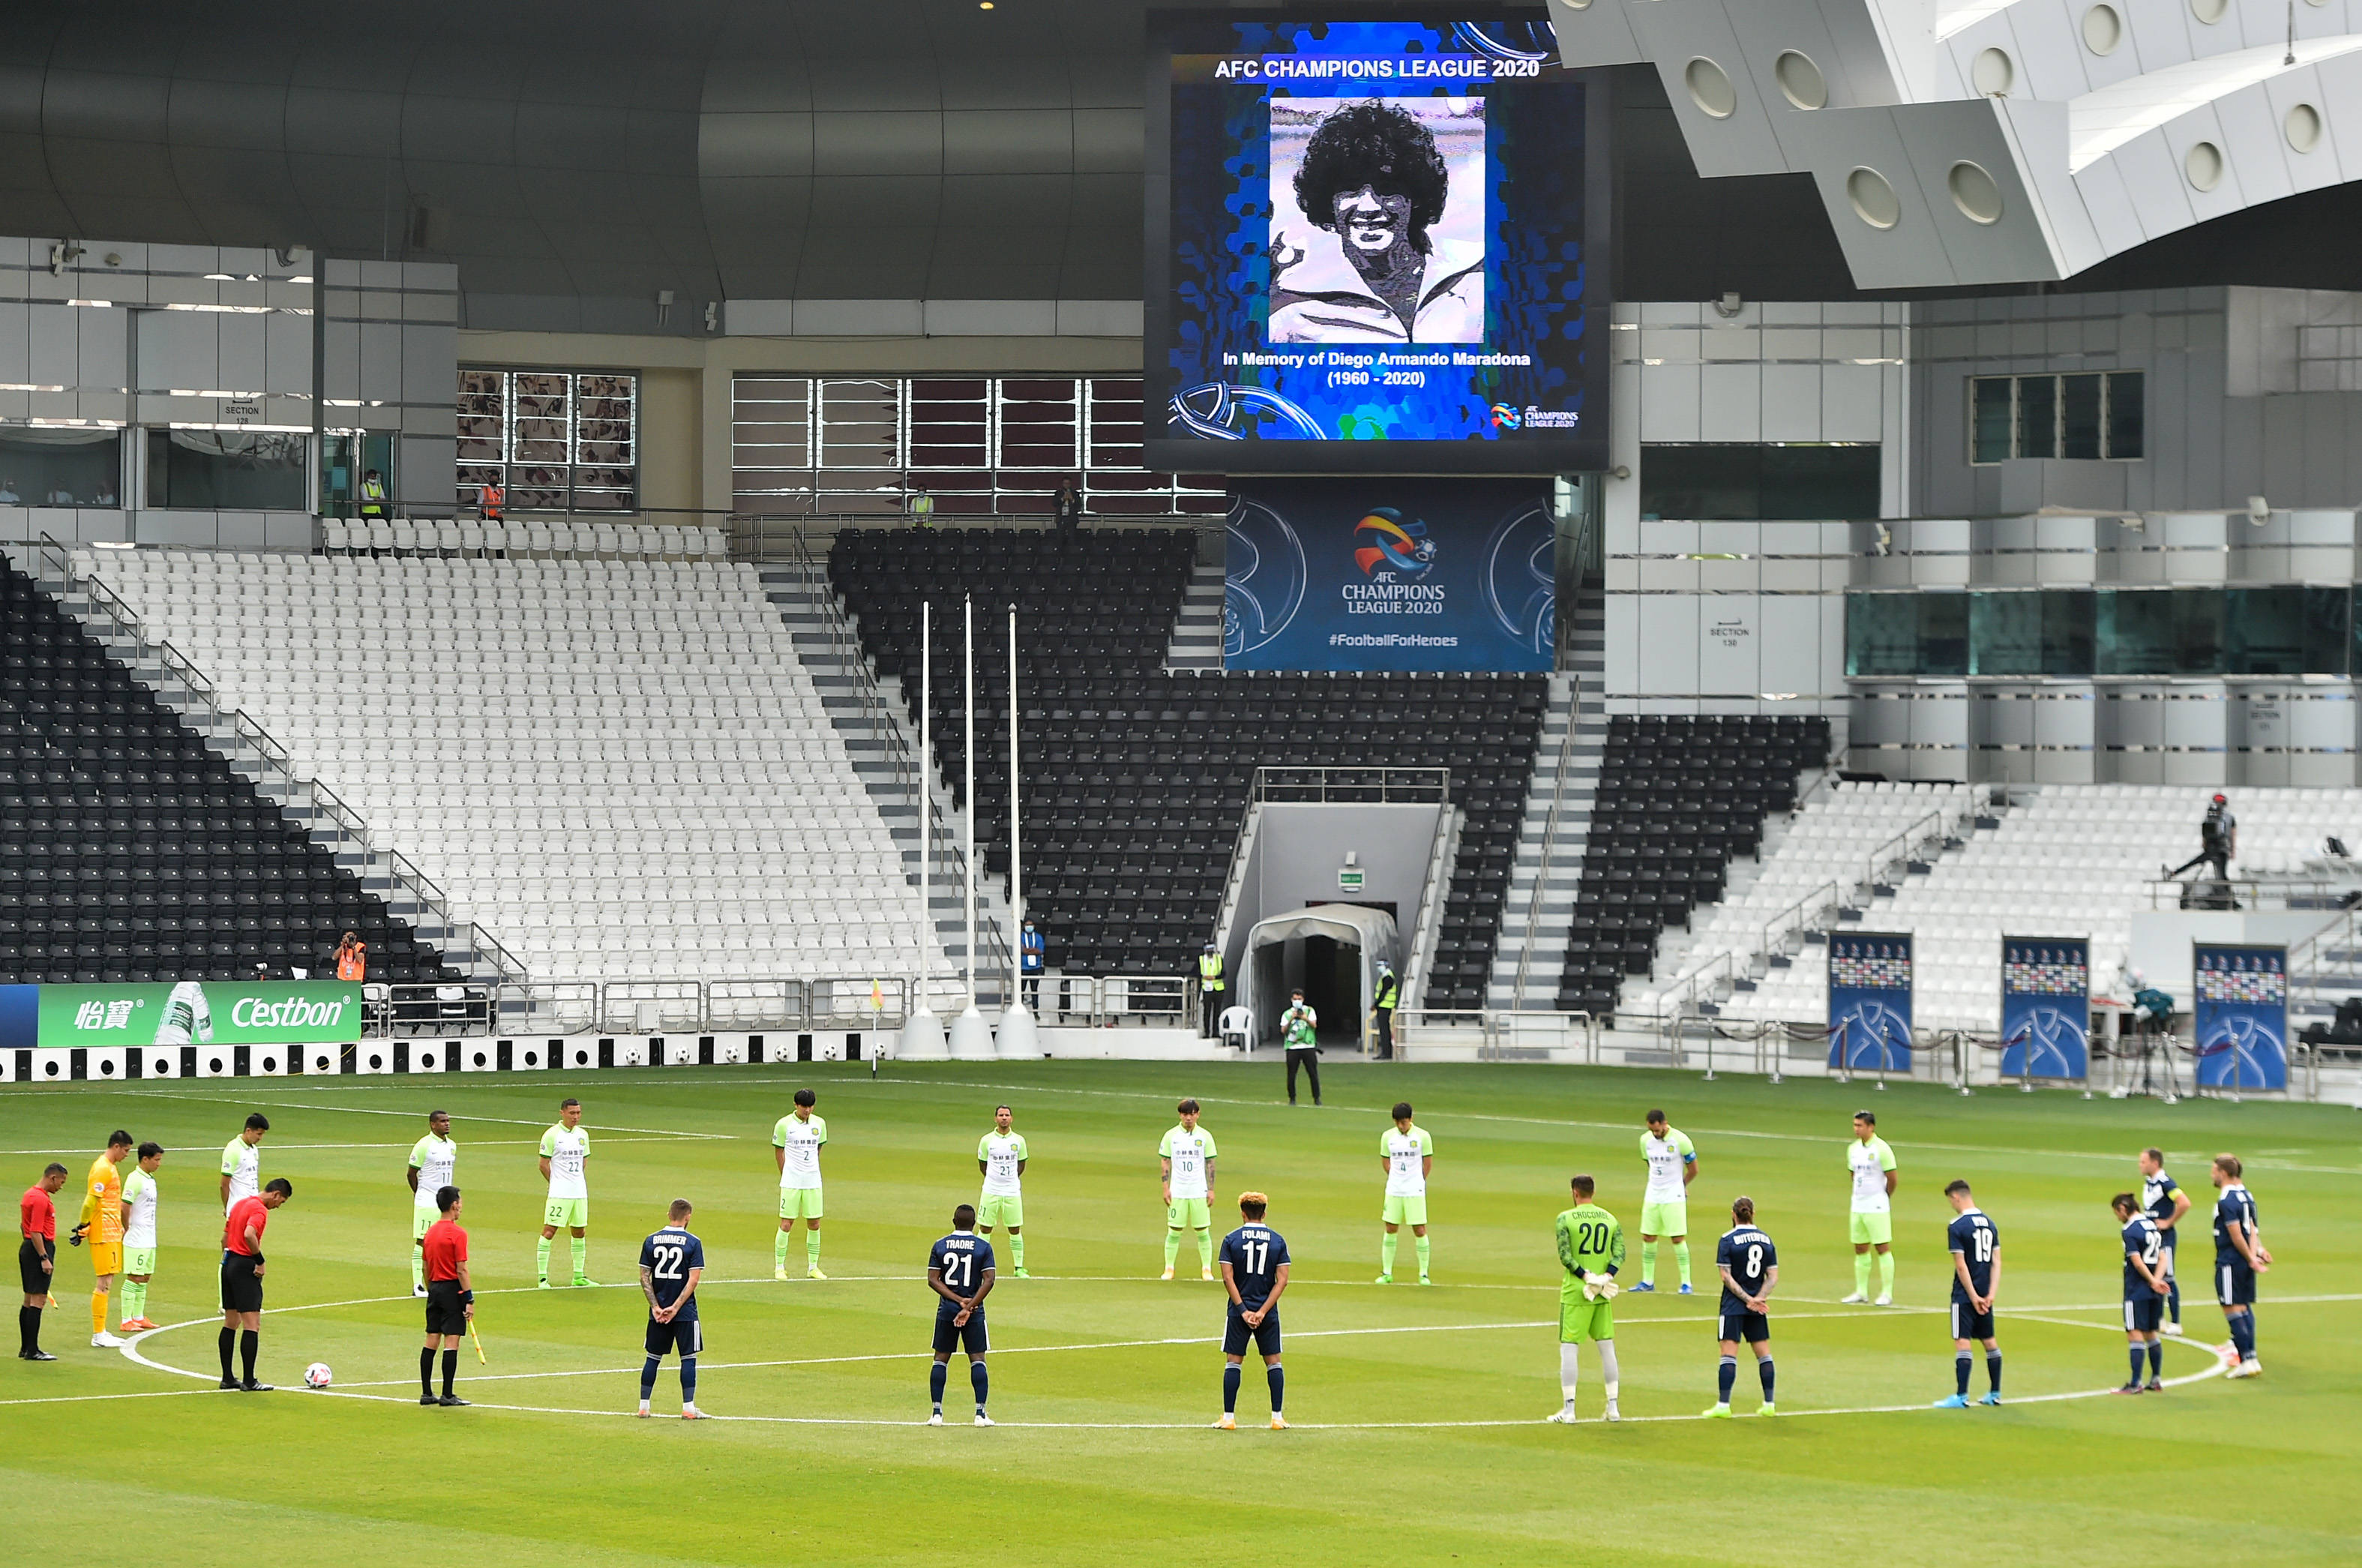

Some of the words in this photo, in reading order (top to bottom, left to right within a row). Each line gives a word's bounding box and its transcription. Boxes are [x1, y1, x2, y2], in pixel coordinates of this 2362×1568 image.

[1214, 59, 1259, 79] AFC
[1263, 59, 1393, 79] CHAMPIONS
[1398, 59, 1487, 77] LEAGUE
[1491, 59, 1540, 77] 2020
[1222, 352, 1238, 366] In
[1242, 351, 1305, 369] Memory
[1308, 351, 1325, 366] of
[1328, 351, 1374, 369] Diego
[1377, 352, 1449, 366] Armando
[1452, 352, 1531, 366] Maradona
[1327, 371, 1369, 388] (1960
[1382, 371, 1425, 388] 2020)
[225, 406, 259, 415] SECTION
[1524, 412, 1579, 421] CHAMPIONS
[236, 417, 249, 425] 128
[1372, 571, 1397, 583] AFC
[1341, 584, 1446, 601] CHAMPIONS
[1347, 601, 1403, 614] LEAGUE
[1404, 601, 1443, 614] 2020
[1710, 628, 1750, 637] SECTION
[1329, 634, 1458, 647] #FootballForHeroes
[74, 1000, 134, 1030] 怡寶
[803, 1150, 810, 1161] 2
[568, 1162, 580, 1172] 22
[1000, 1165, 1010, 1176] 21
[1182, 1161, 1193, 1172] 10
[442, 1171, 451, 1183] 11
[781, 1198, 786, 1210] 2
[549, 1206, 562, 1218] 22
[421, 1219, 431, 1231] 11
[652, 1234, 687, 1246] GRIMMER
[1242, 1229, 1271, 1241] FOLAMI
[1578, 1222, 1609, 1255] 20
[946, 1239, 976, 1251] TRAORE
[1972, 1227, 1994, 1263] 19
[112, 1251, 117, 1264] 1
[136, 1254, 144, 1266] 6
[653, 1246, 684, 1280] 22
[1242, 1240, 1269, 1276] 11
[1746, 1243, 1764, 1279] 8
[943, 1252, 973, 1288] 21
